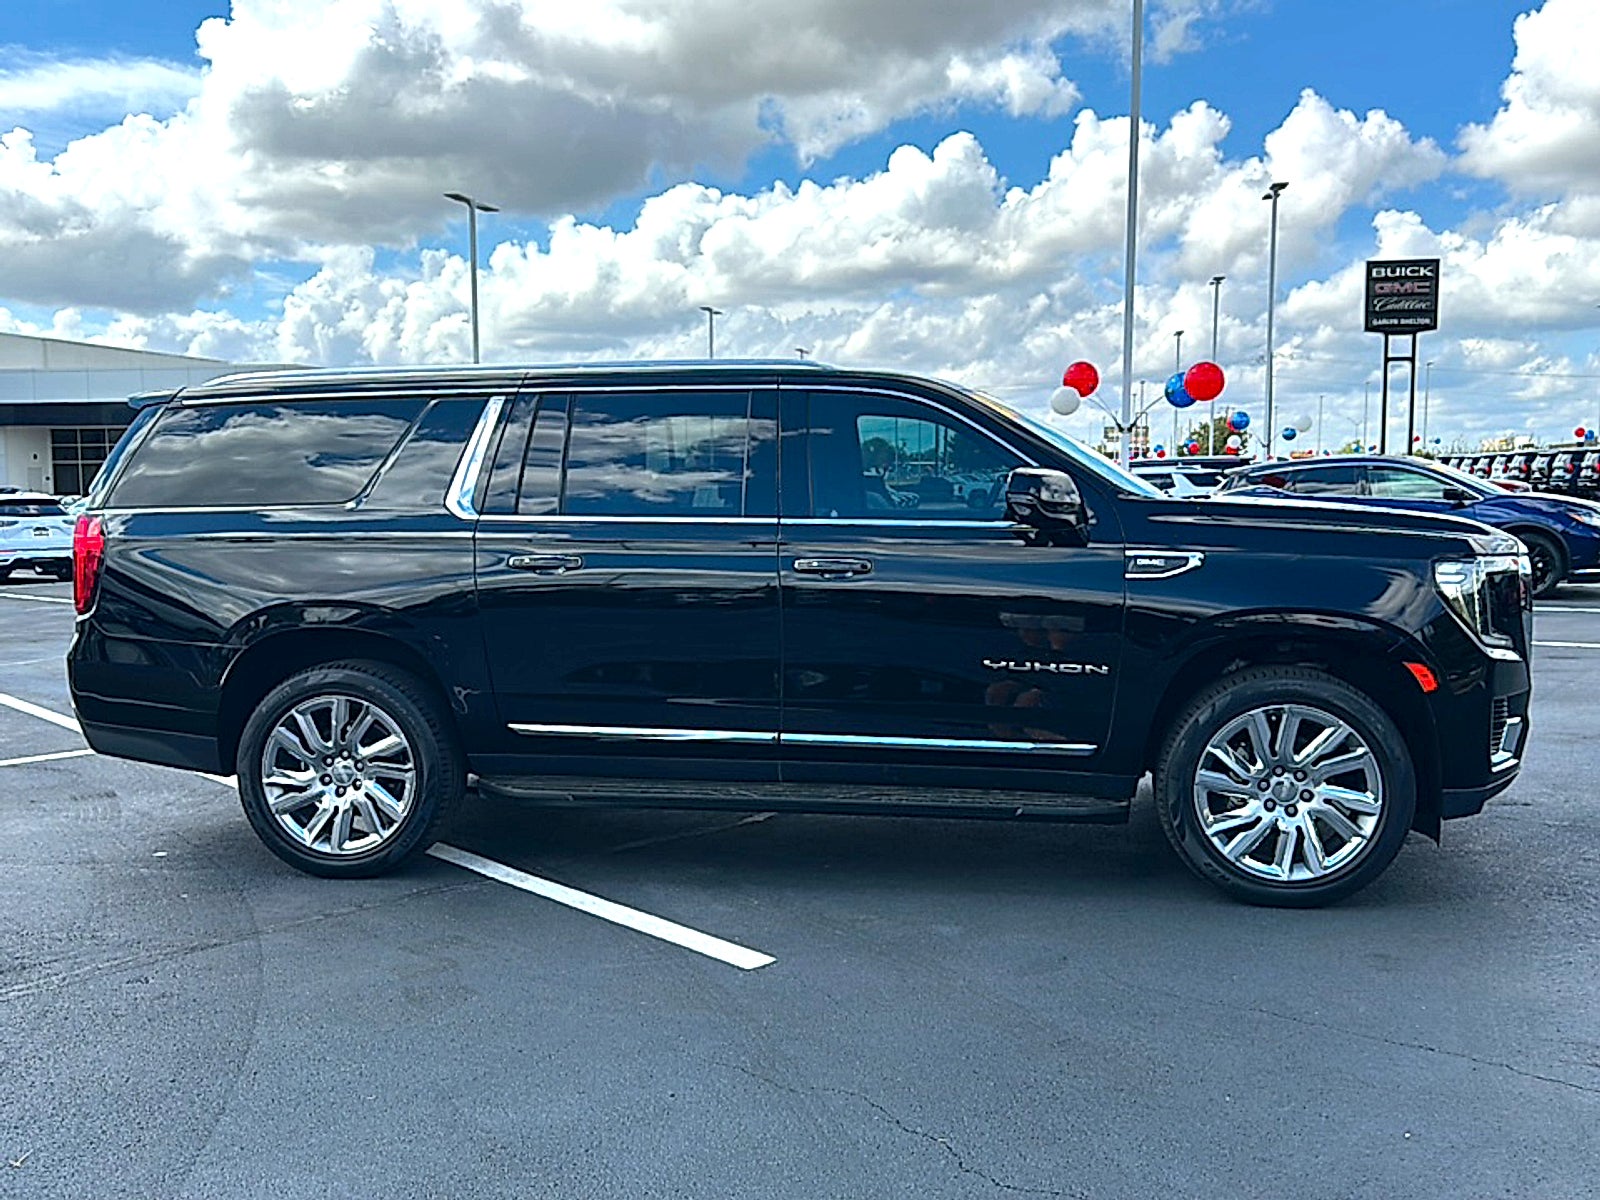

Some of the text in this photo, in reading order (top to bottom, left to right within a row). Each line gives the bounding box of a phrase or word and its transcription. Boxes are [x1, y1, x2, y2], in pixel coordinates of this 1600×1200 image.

[1371, 266, 1434, 278] BUICK
[1374, 281, 1431, 295] GMC
[1373, 296, 1431, 312] Cadillac
[982, 659, 1110, 675] YUKON
